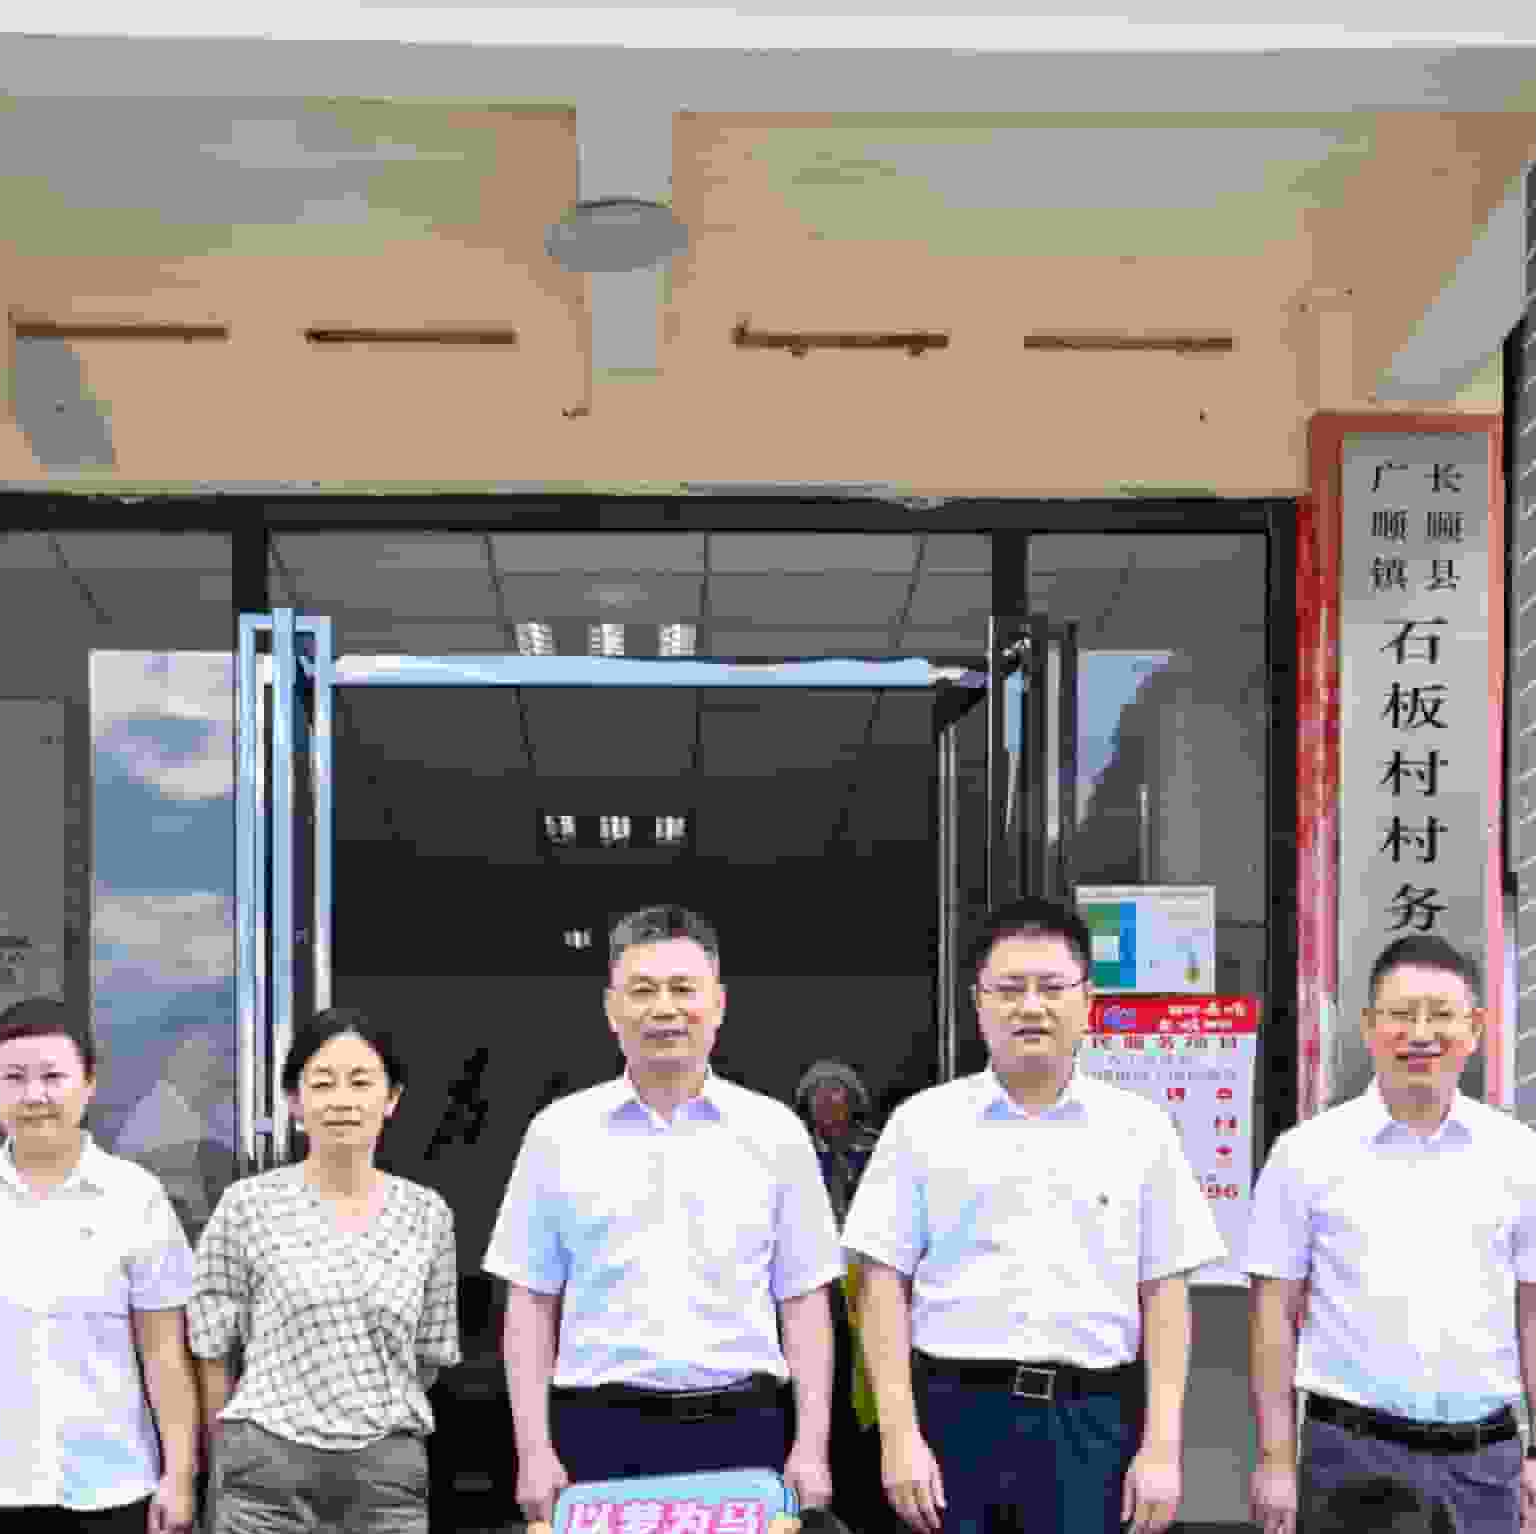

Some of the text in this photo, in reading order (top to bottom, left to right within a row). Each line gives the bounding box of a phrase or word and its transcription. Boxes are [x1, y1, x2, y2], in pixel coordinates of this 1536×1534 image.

[1370, 460, 1410, 593] 广顺镇
[1422, 462, 1464, 593] 长顺县
